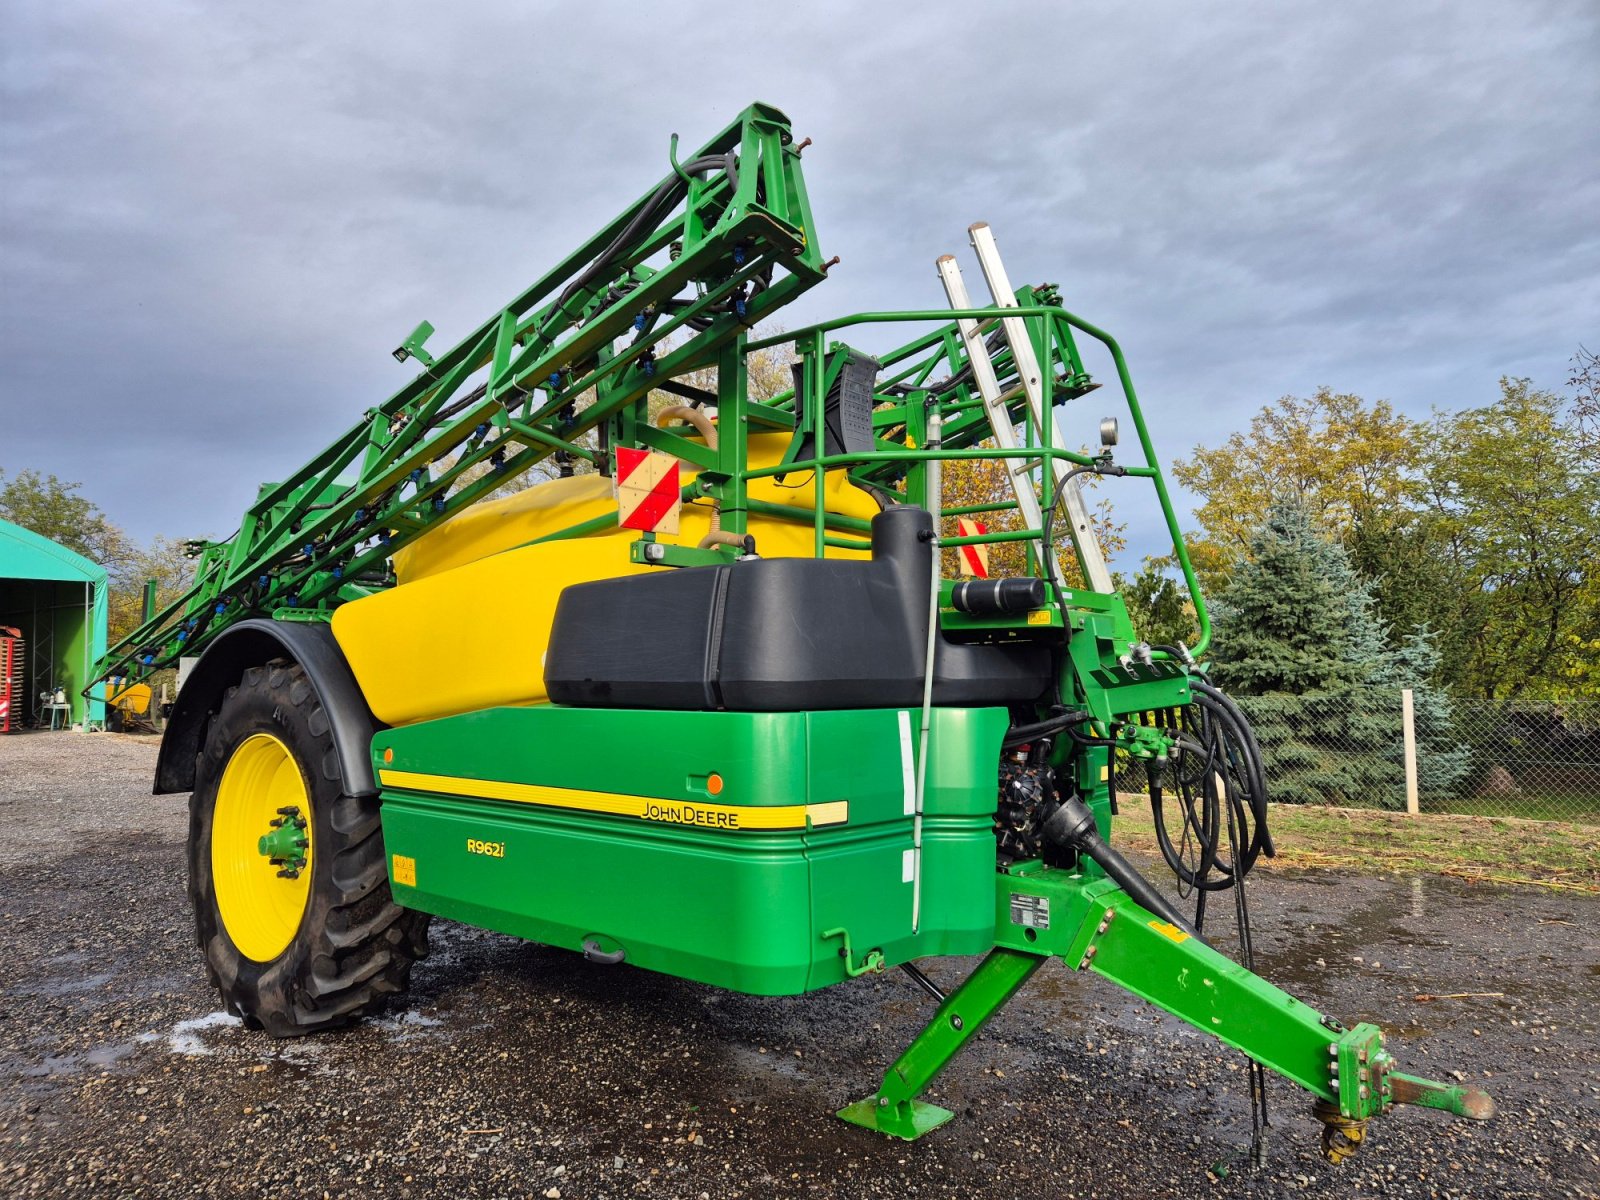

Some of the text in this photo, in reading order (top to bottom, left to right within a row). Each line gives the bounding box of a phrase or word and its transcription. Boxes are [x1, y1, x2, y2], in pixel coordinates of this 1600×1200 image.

[642, 802, 739, 827] JOHN DEERE
[467, 838, 505, 858] R962i
